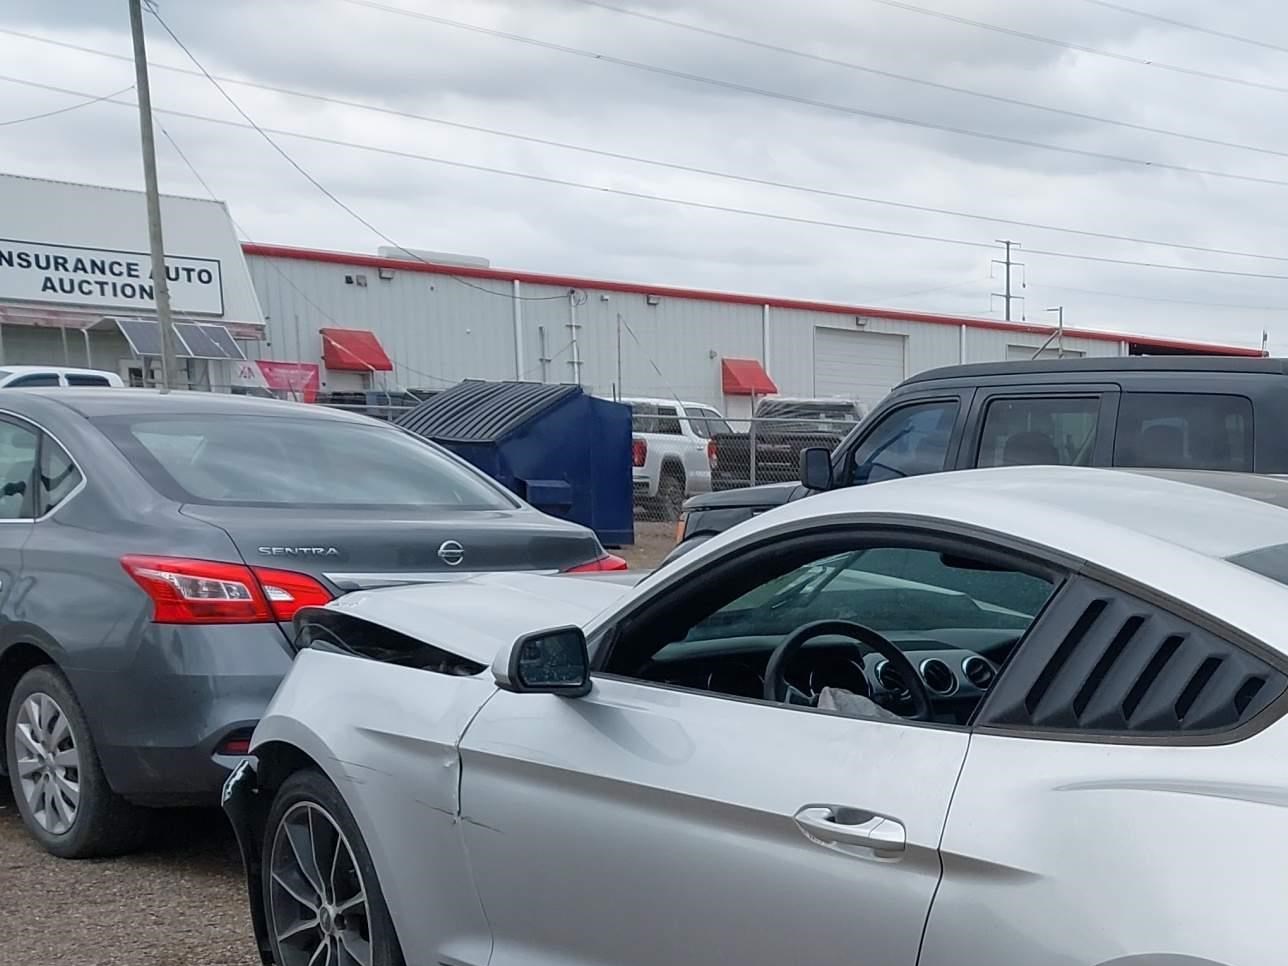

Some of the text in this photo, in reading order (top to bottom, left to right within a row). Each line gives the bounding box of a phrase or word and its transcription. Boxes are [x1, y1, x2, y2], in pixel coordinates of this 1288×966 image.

[0, 250, 213, 285] NSURANCE UTO
[258, 546, 340, 556] SENTRA
